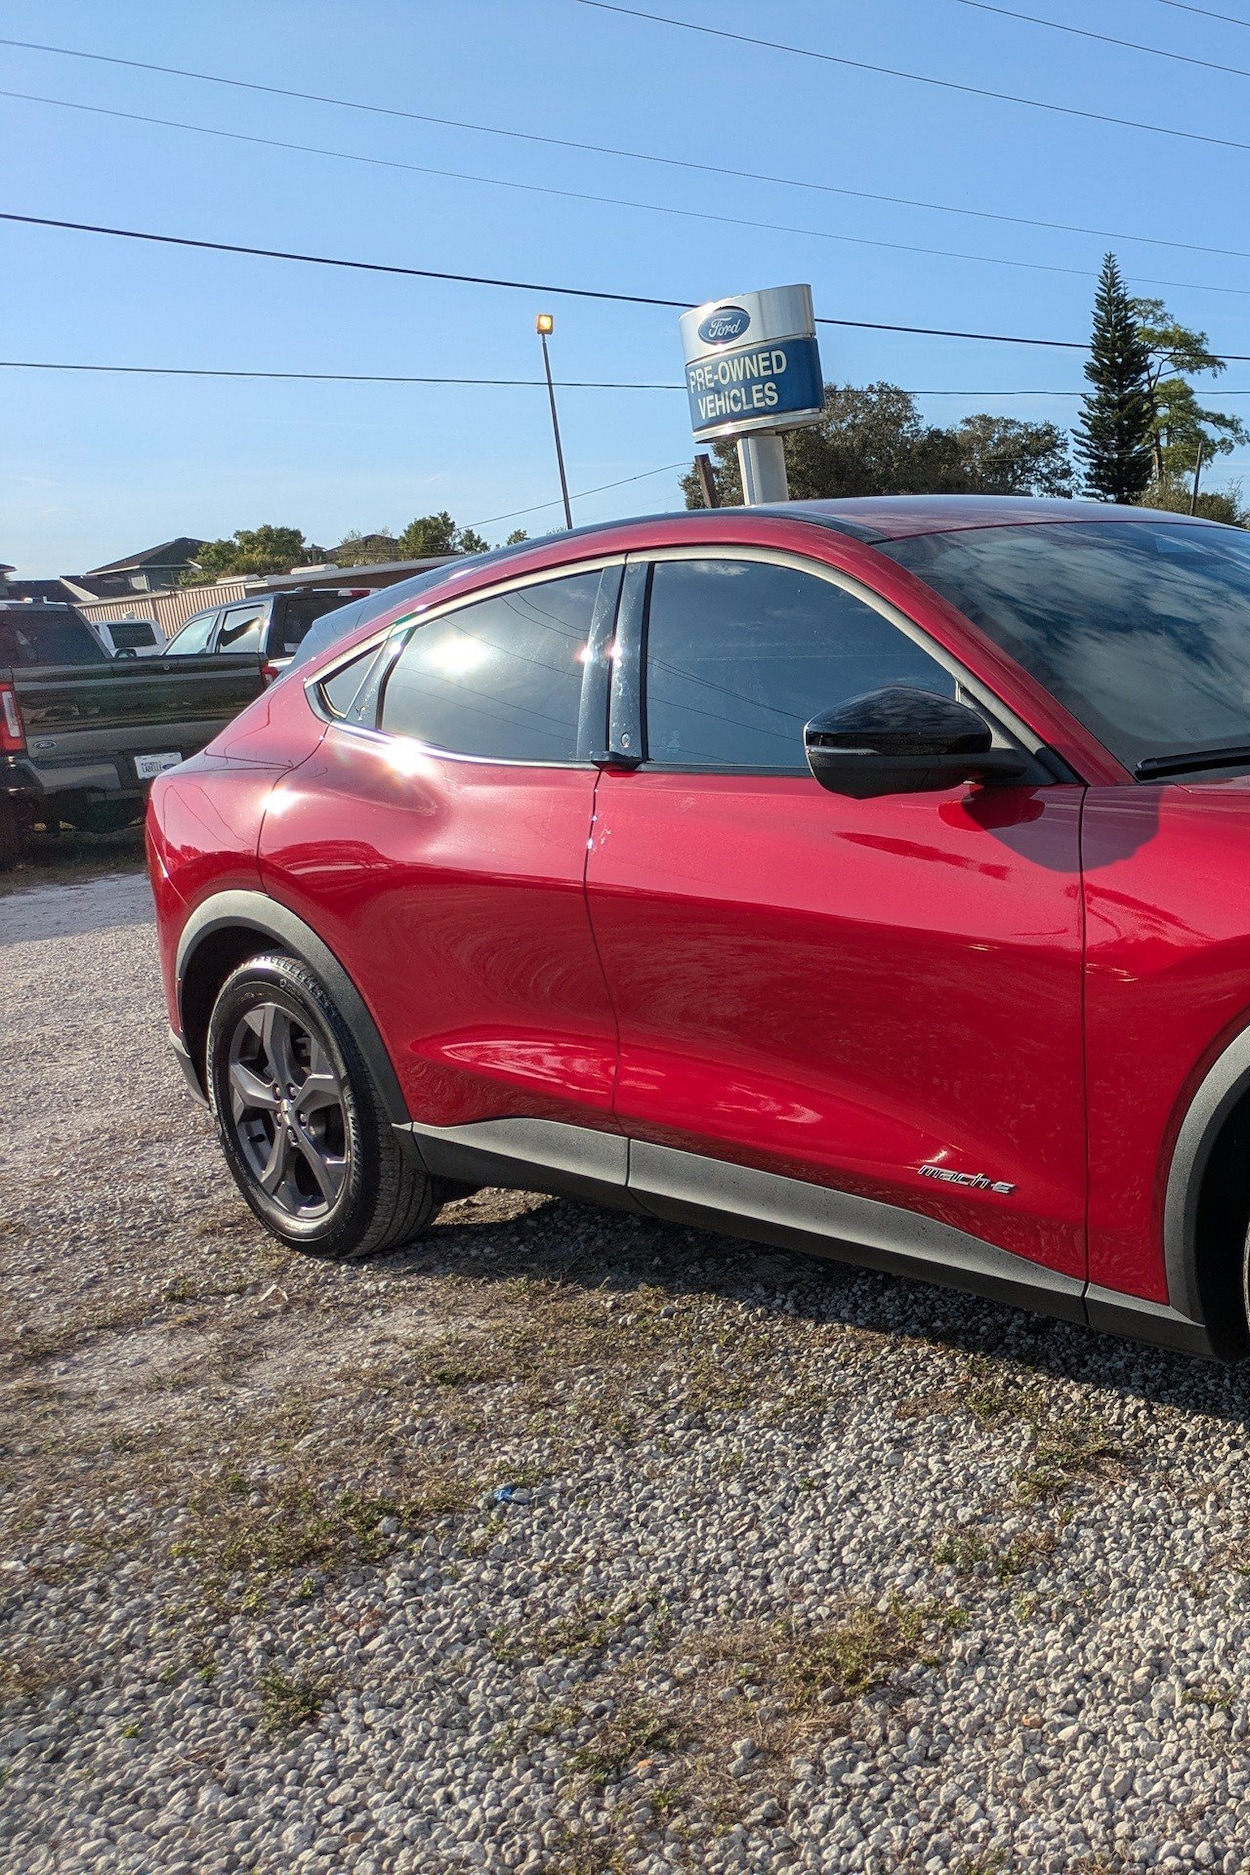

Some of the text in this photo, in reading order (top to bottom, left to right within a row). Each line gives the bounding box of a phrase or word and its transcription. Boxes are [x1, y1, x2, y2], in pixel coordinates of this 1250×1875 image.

[709, 316, 741, 338] Ford
[689, 350, 787, 394] PRE-OWNED
[698, 382, 778, 420] VEHICLES
